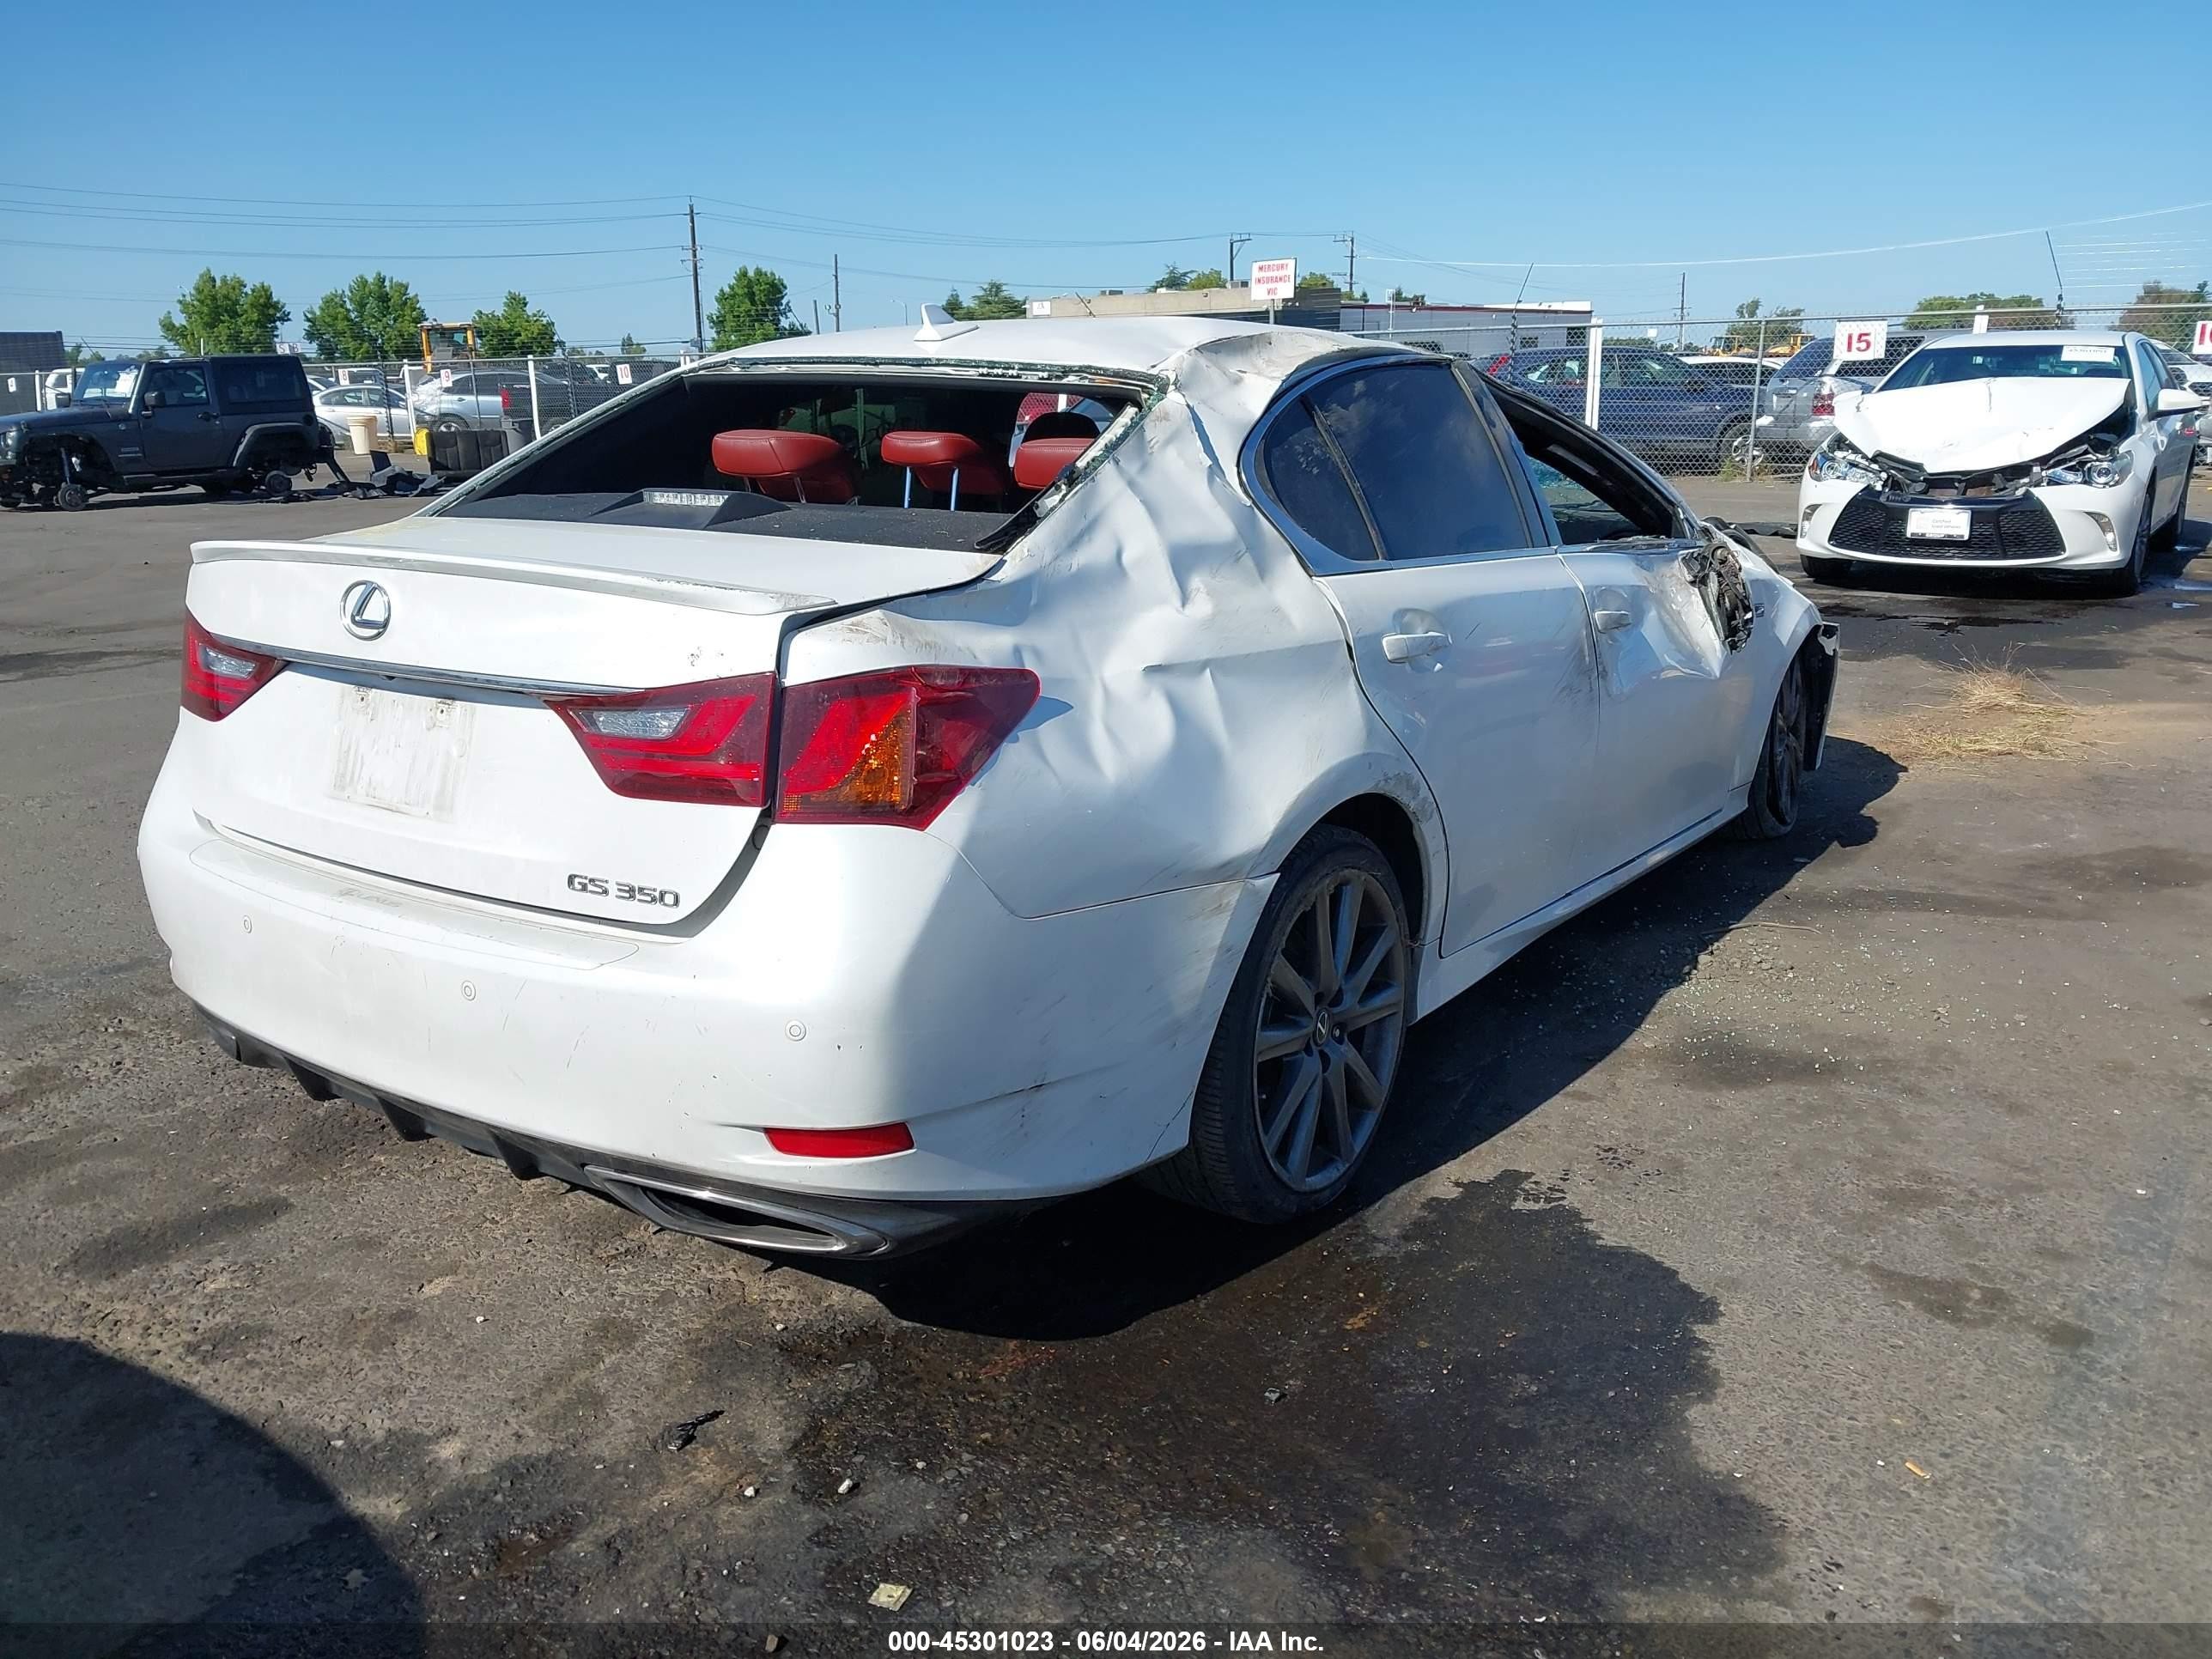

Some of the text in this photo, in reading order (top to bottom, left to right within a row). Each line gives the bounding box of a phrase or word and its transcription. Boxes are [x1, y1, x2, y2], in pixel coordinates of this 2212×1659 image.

[1257, 263, 1289, 273] MERCURY
[1255, 275, 1291, 285] INSURANCE
[1267, 288, 1279, 296] VIC
[1846, 332, 1871, 353] 15
[279, 343, 286, 354] S
[444, 370, 451, 382] 9
[619, 366, 629, 379] 10
[568, 873, 681, 908] GS 350
